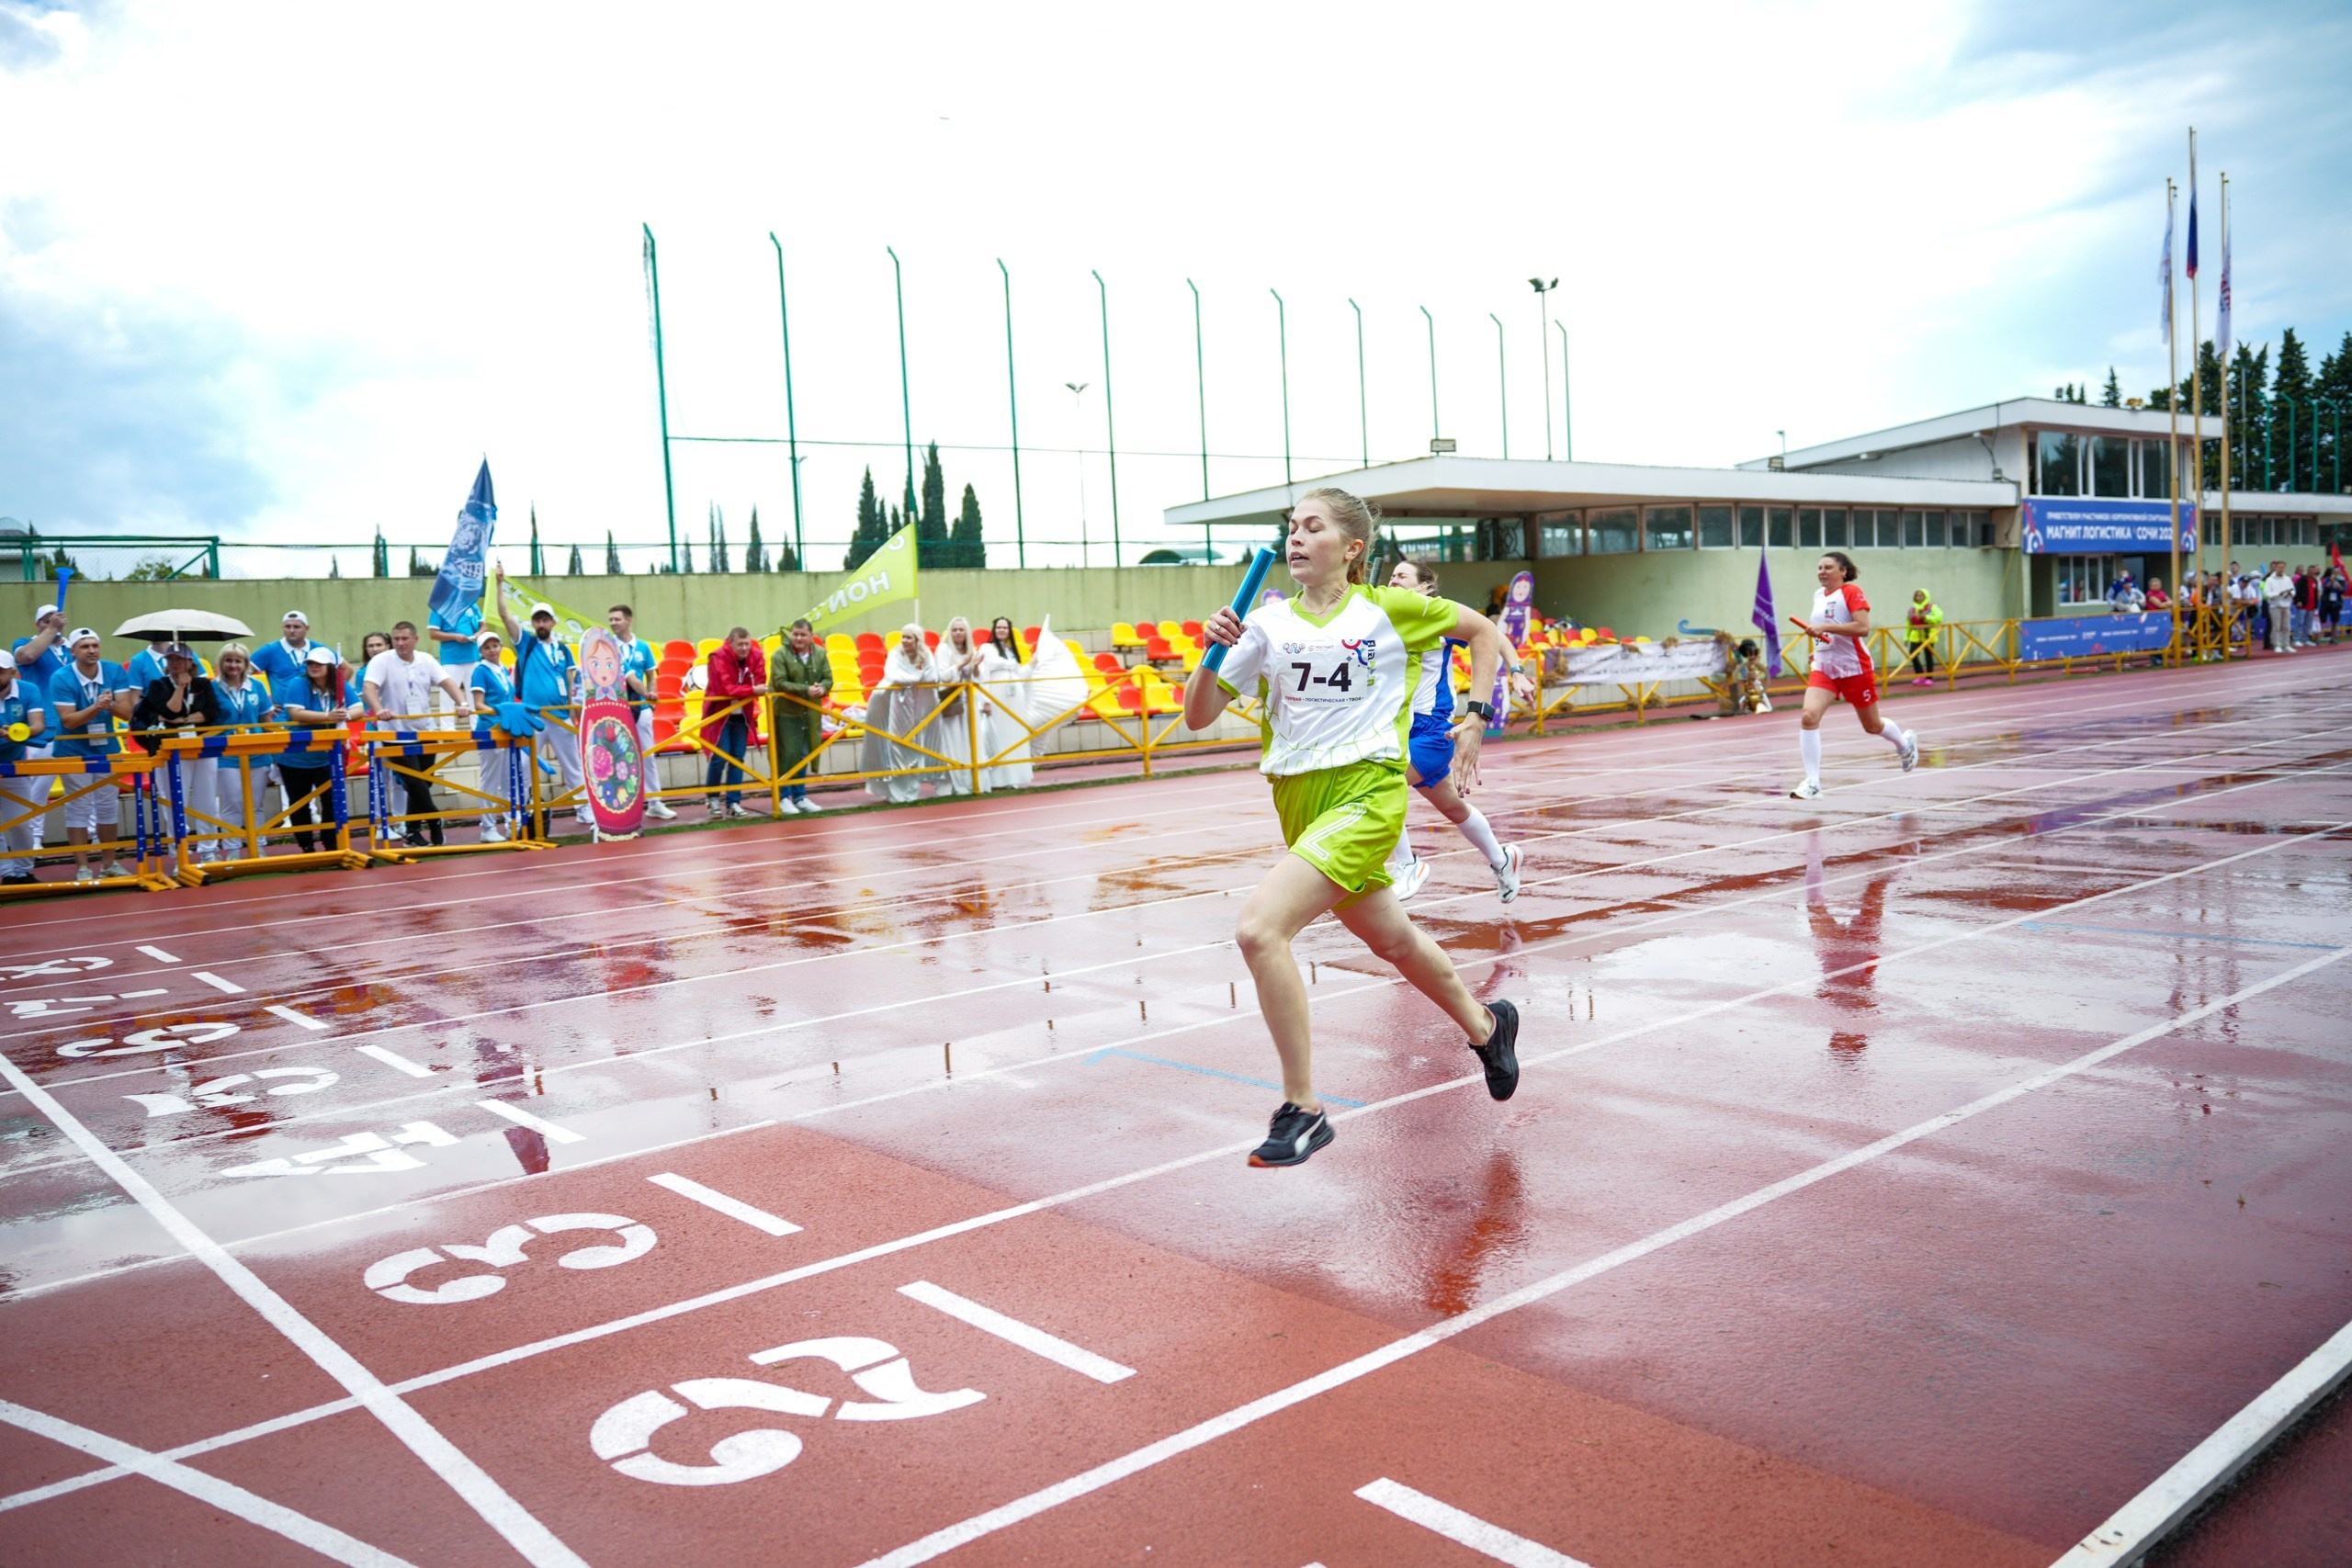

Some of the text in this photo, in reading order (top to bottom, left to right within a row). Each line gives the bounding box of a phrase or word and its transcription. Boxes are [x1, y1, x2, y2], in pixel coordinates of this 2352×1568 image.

[2046, 525, 2174, 540] МАГНИТ ЛОГИСТИКА СОЧИ 202
[1291, 662, 1351, 692] 7-4
[1862, 689, 1871, 702] 5
[3, 988, 169, 1019] 7
[56, 1022, 241, 1057] 6
[121, 1066, 341, 1117] 5
[220, 1120, 462, 1178] 4
[363, 1213, 658, 1304] 3
[589, 1335, 988, 1486] 2
